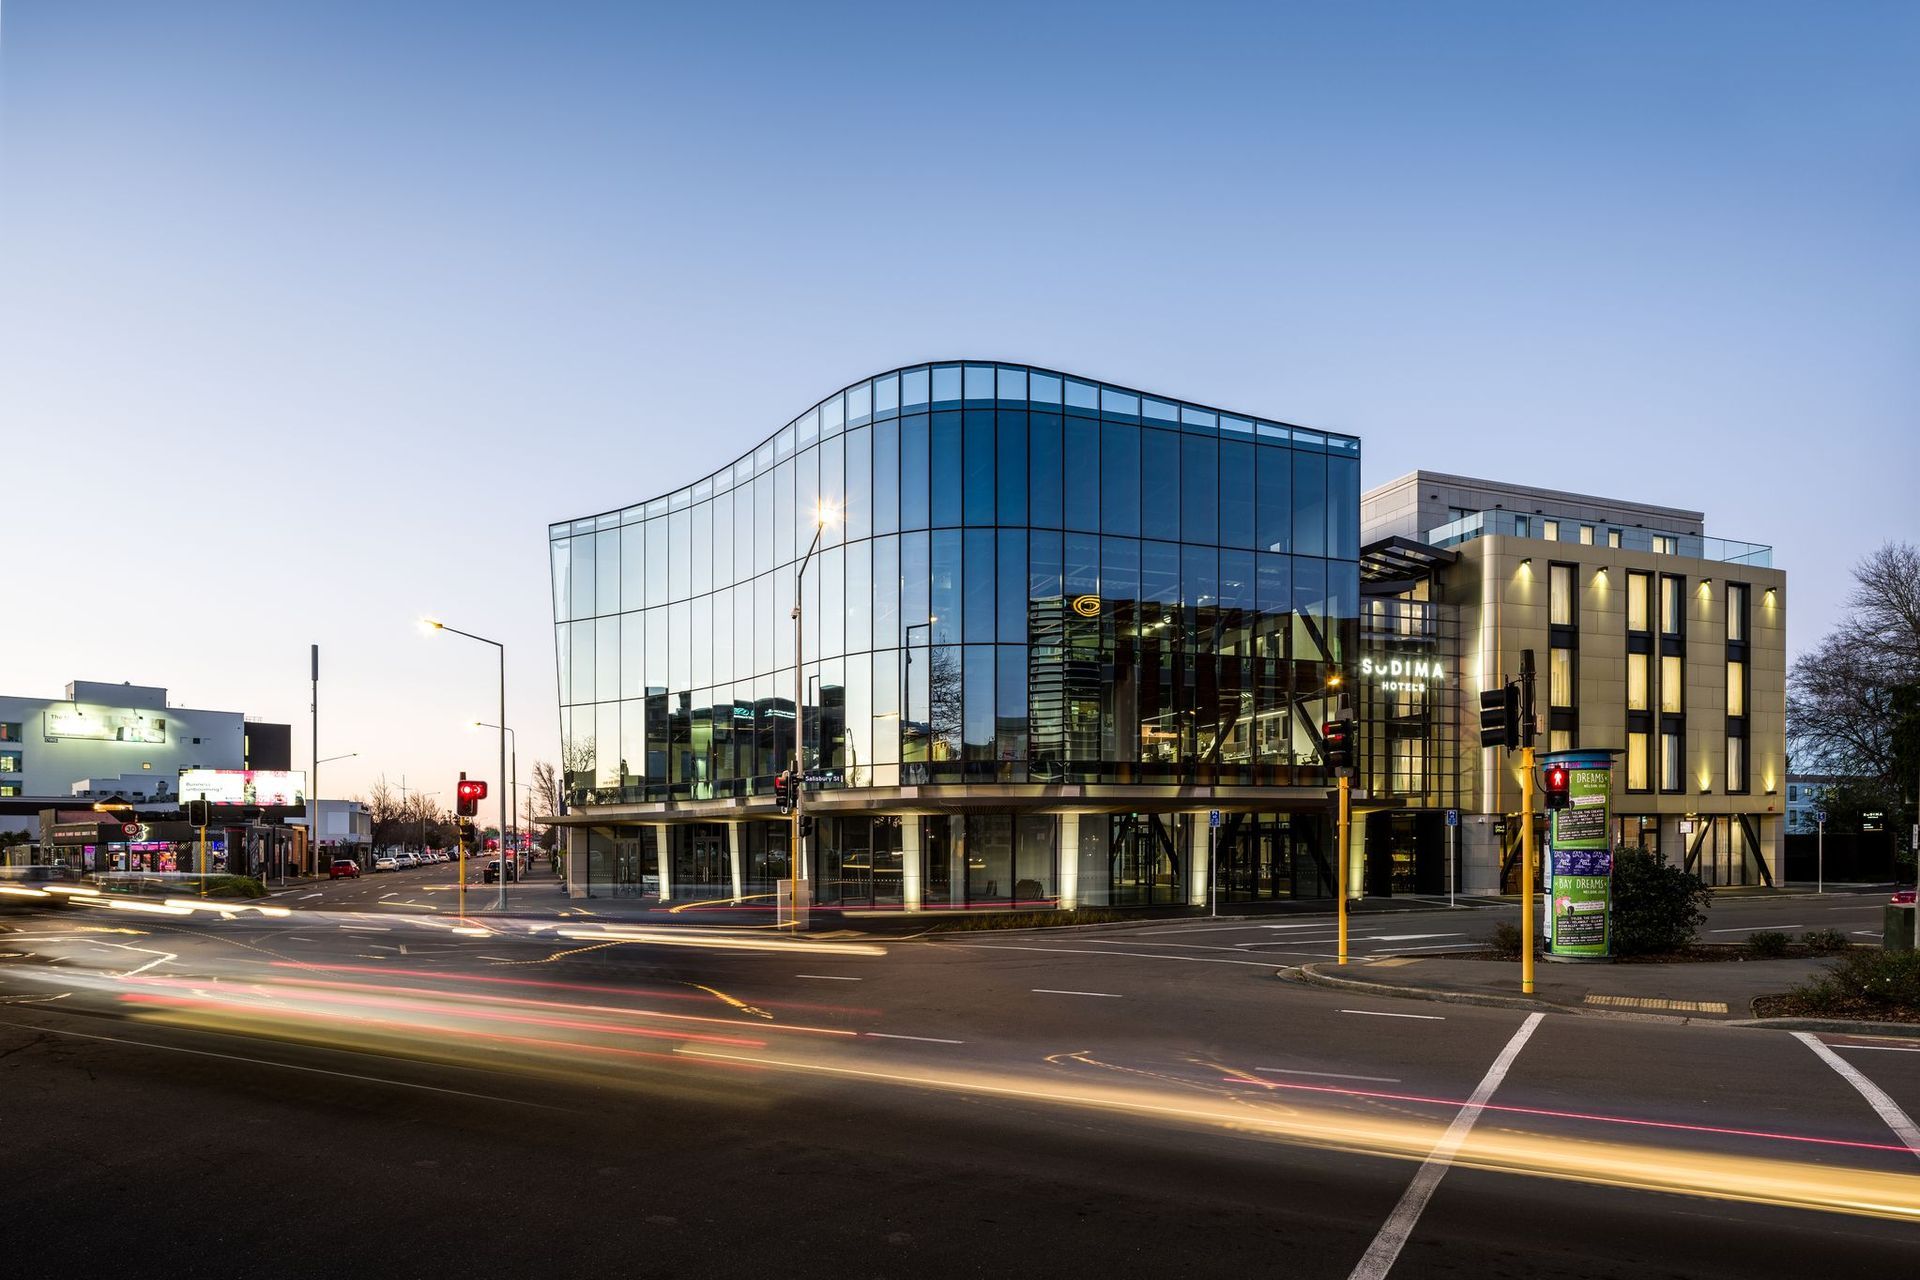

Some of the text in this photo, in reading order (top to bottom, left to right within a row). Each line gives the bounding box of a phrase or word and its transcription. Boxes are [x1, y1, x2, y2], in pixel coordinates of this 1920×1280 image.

[1382, 681, 1425, 692] HOTELS
[1576, 773, 1604, 783] DREAMS
[1559, 878, 1572, 889] BAY
[1576, 878, 1604, 889] DREAMS
